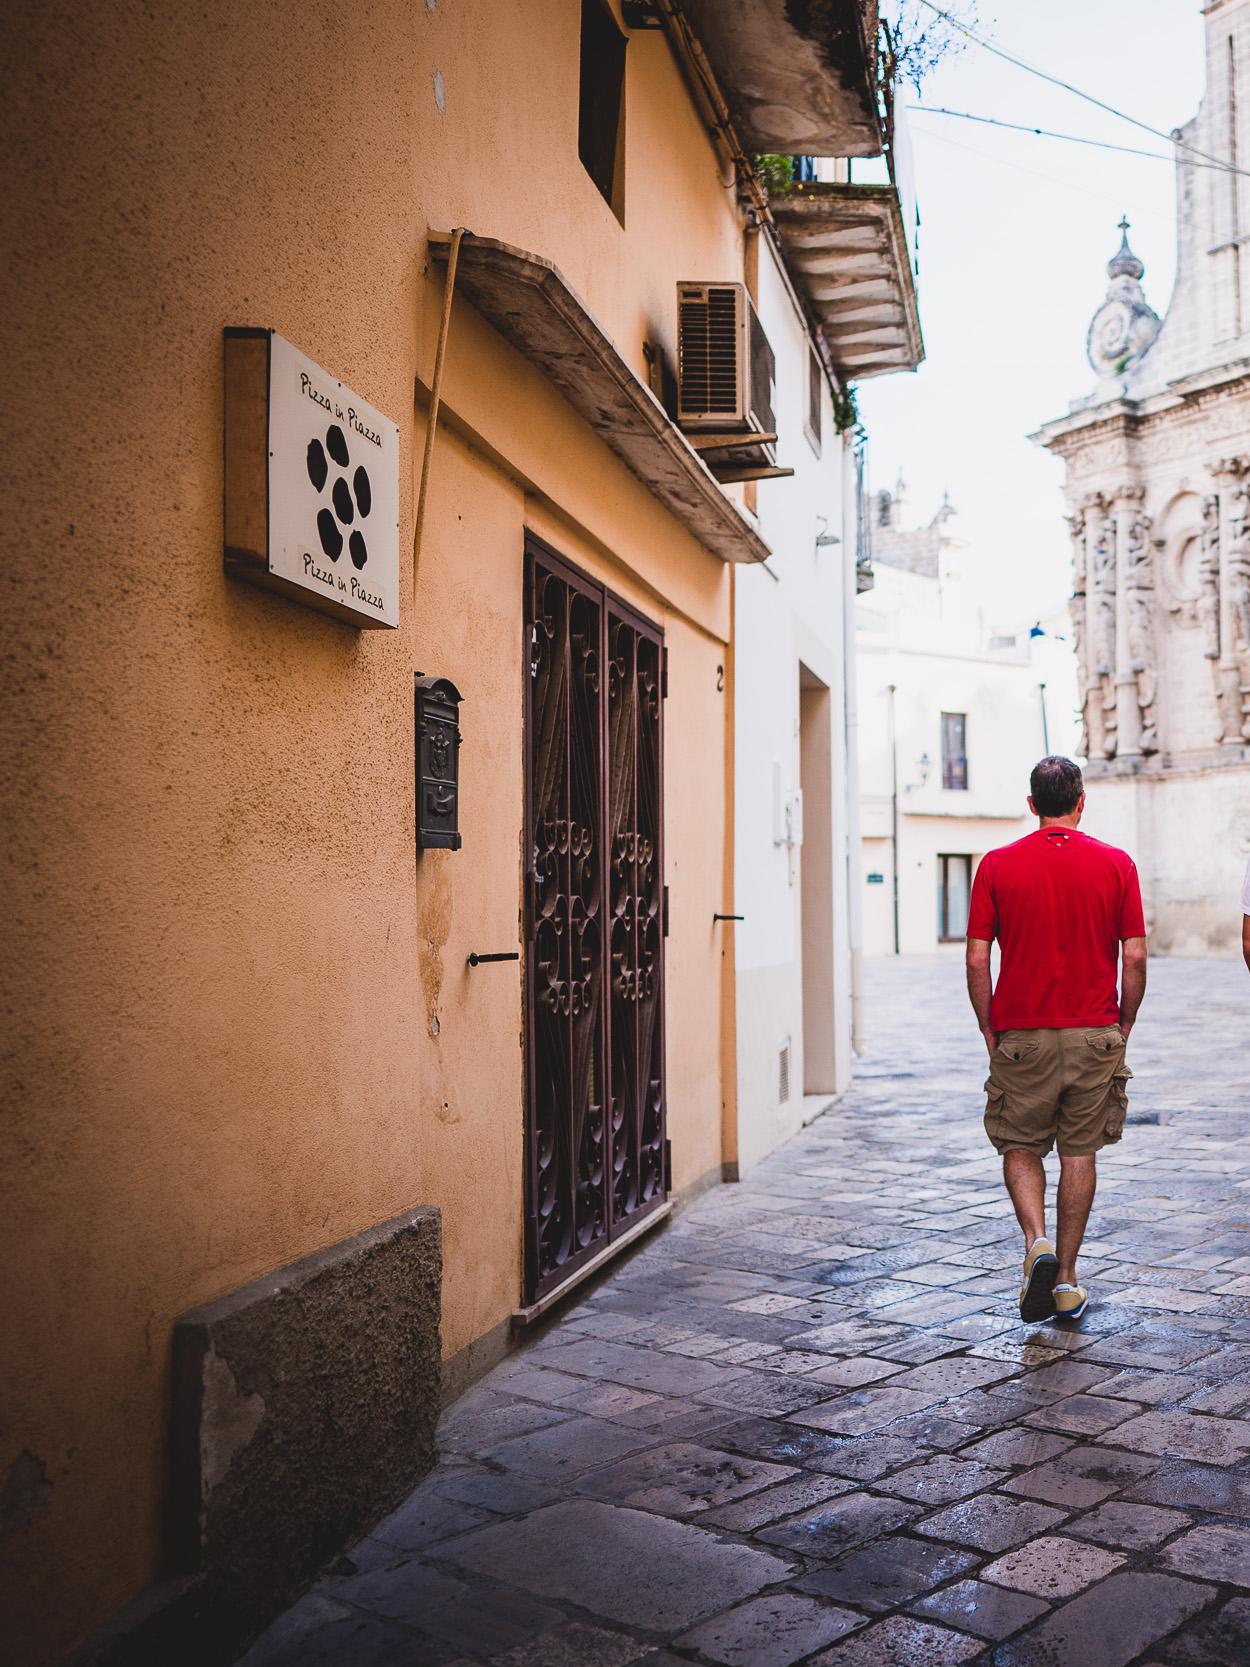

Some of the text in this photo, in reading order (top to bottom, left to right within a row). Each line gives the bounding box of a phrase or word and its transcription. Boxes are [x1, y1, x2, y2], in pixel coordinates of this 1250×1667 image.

[300, 372, 383, 448] Pizza in Piazza
[302, 553, 385, 611] Pizza in Piazza
